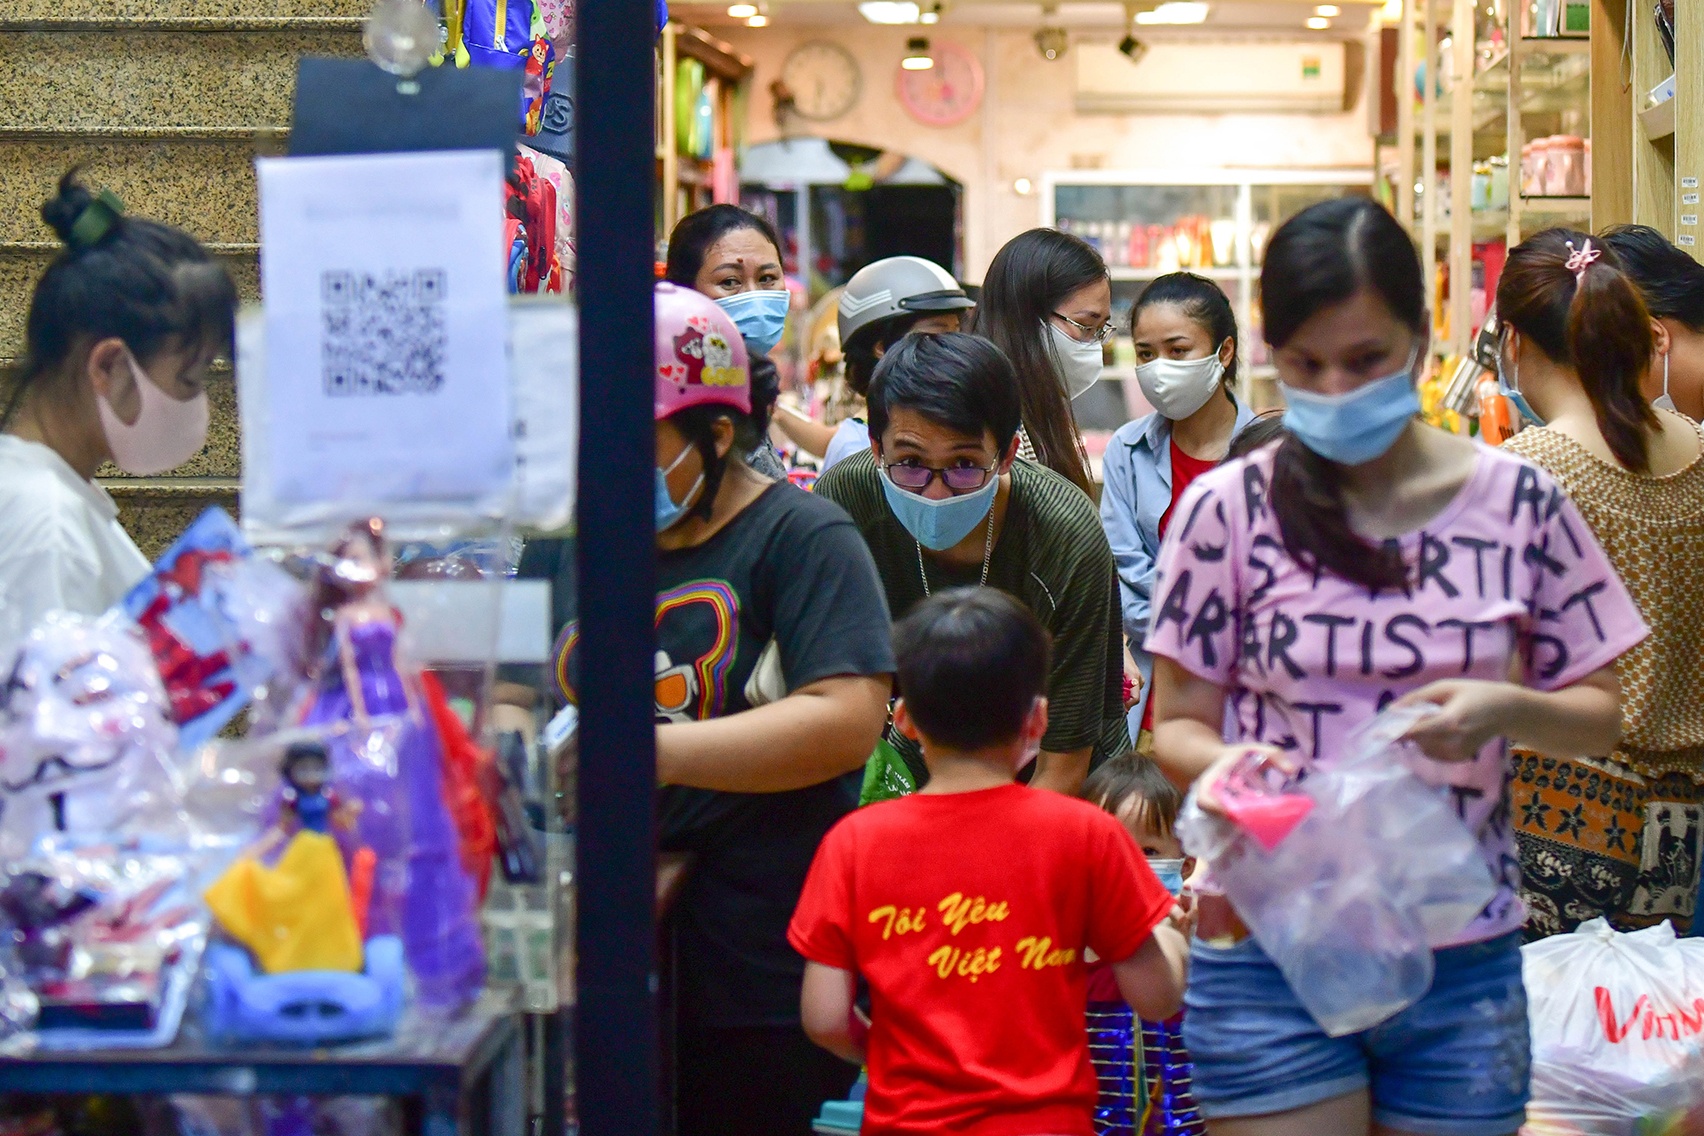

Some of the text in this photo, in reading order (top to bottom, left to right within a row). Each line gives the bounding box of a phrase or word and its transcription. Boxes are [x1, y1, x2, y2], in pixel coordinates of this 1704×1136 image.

[1242, 609, 1496, 681] ARTIST
[868, 891, 1010, 941] Tôi Yêu
[928, 945, 1002, 983] Việt
